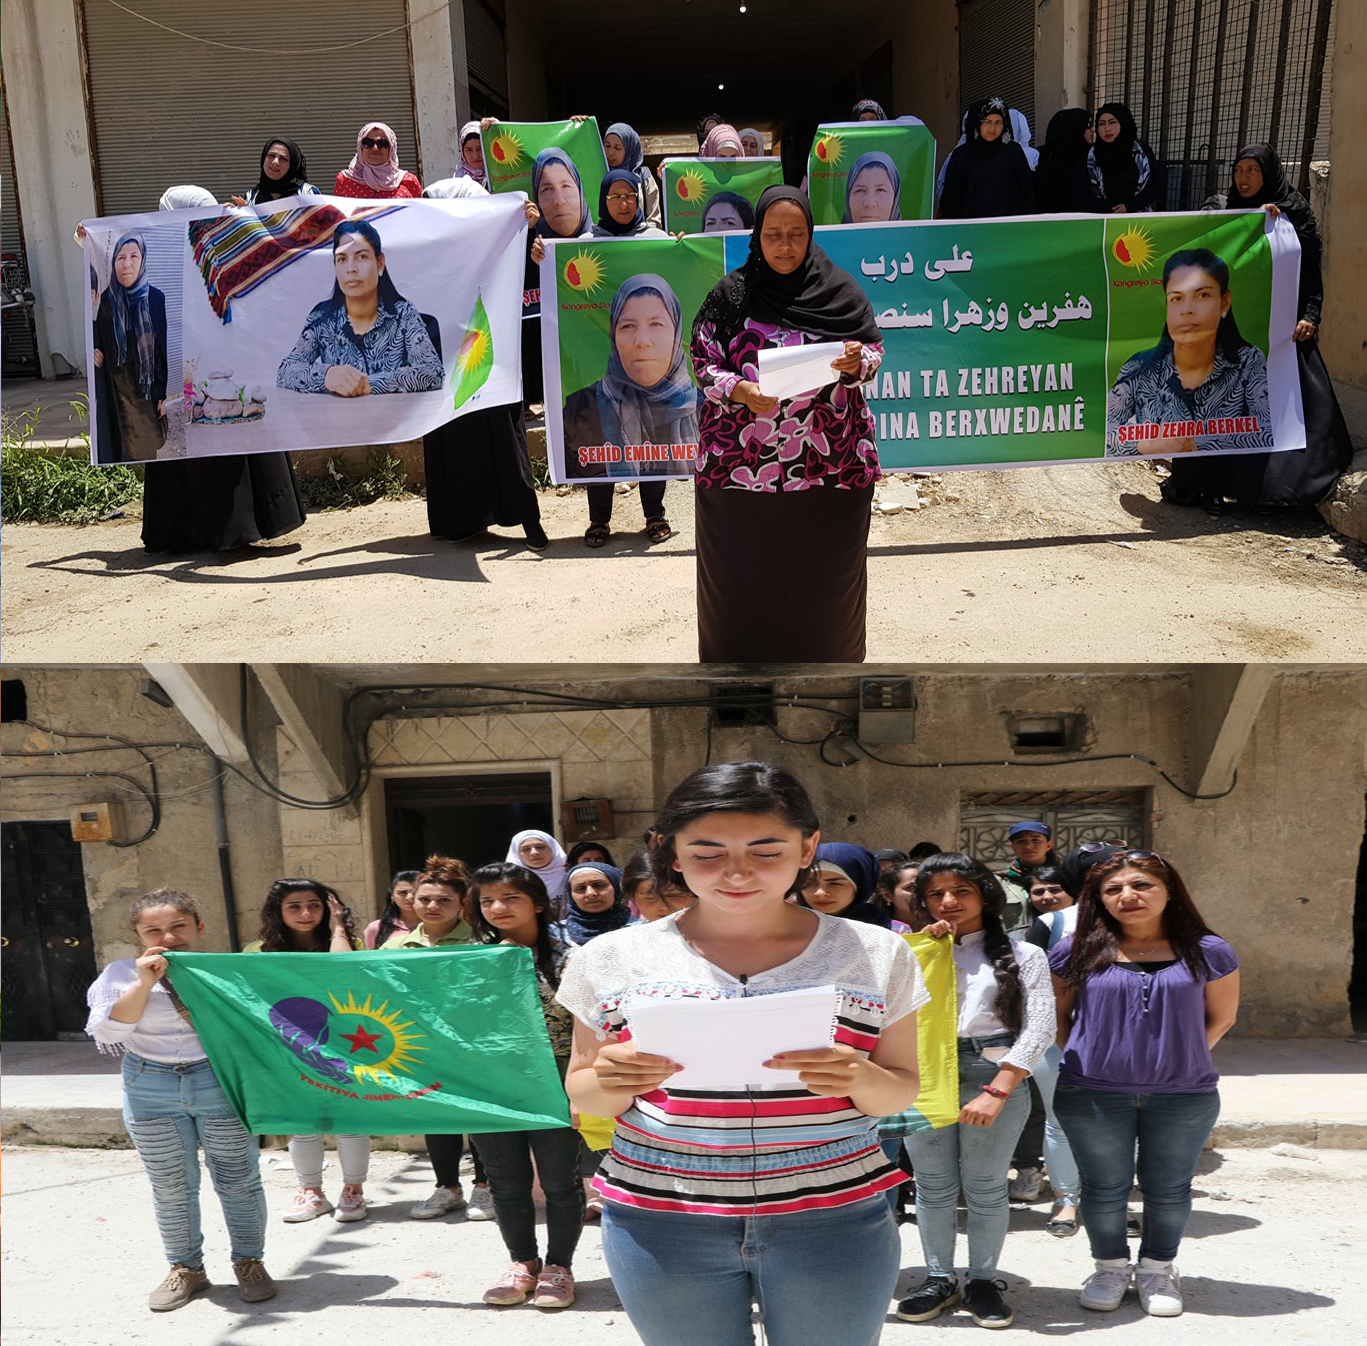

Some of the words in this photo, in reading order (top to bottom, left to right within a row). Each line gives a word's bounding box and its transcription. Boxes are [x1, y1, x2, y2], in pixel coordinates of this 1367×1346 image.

[860, 251, 915, 283] درب
[924, 243, 974, 281] على
[1112, 279, 1149, 289] Kongreya
[561, 302, 598, 312] Kongreya
[941, 297, 1010, 334] وزهرا
[1017, 291, 1093, 331] هفرين
[920, 369, 950, 398] TA
[957, 362, 1075, 397] ZEHREYAN
[875, 411, 920, 440] INA
[928, 396, 1086, 439] BERXWEDANÊ
[1117, 419, 1160, 445] ŞEHÎD
[1162, 420, 1205, 439] ZEHRA
[1207, 416, 1261, 436] BERKEL
[577, 442, 622, 467] ŞEHÎD
[624, 441, 670, 462] EMÎNE
